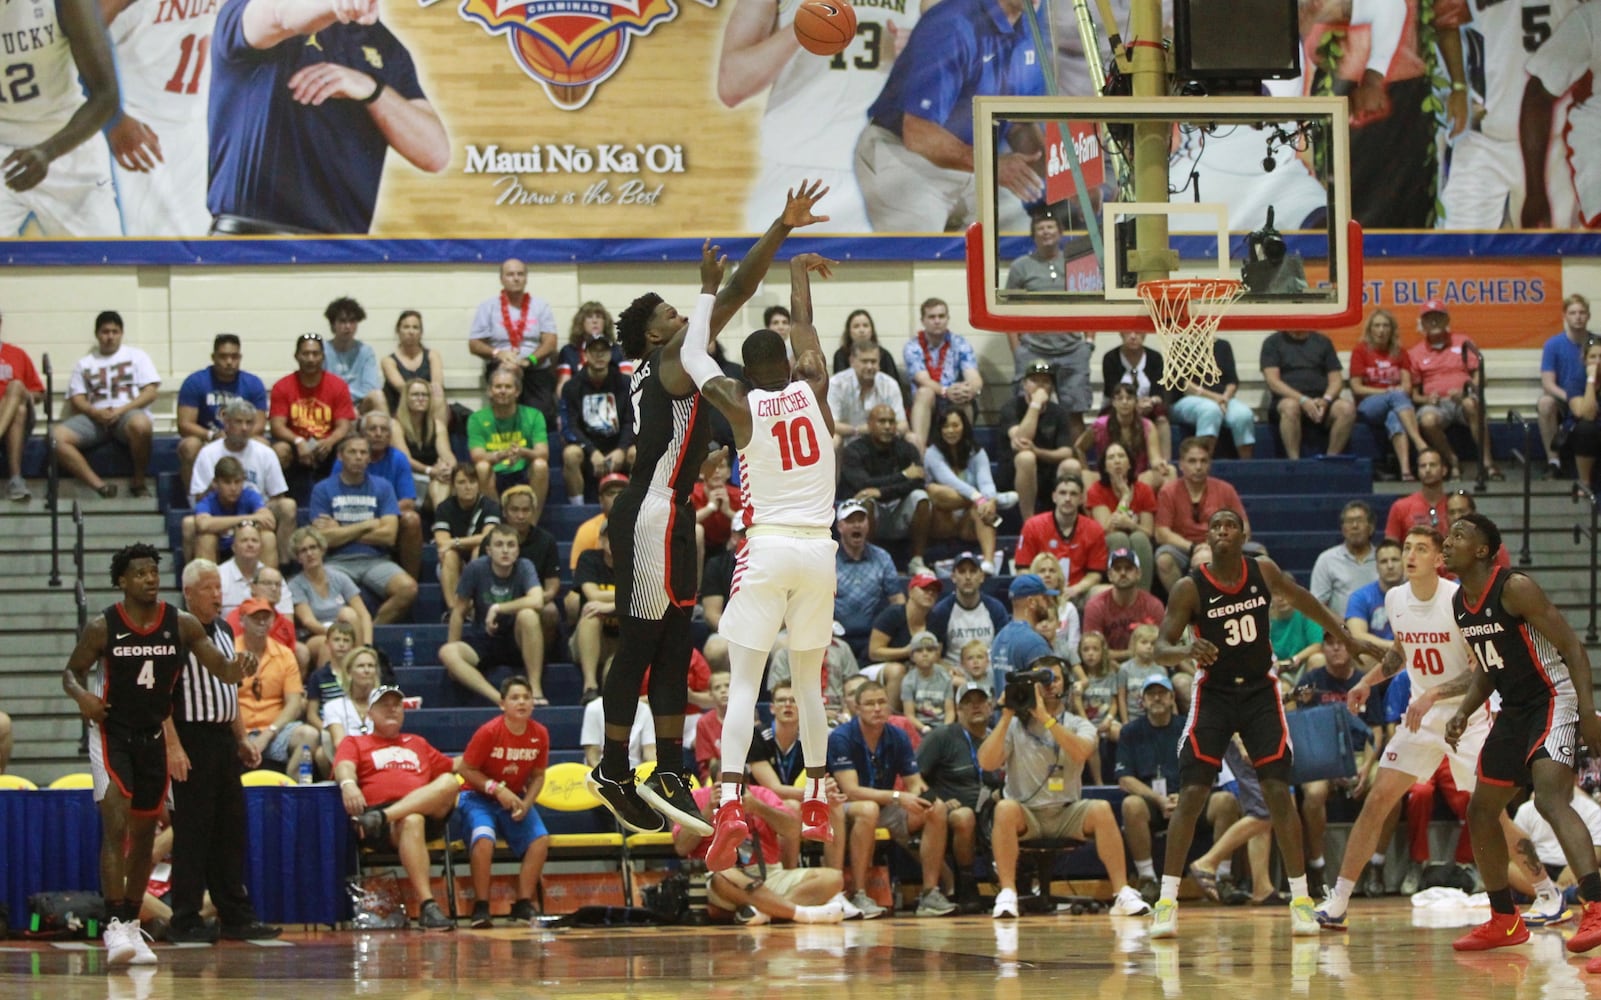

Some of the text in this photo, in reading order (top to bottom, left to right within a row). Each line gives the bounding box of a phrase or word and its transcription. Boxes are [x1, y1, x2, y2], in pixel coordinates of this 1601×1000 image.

[527, 1, 609, 14] CHAMINADE
[1521, 4, 1552, 53] 5
[464, 145, 543, 173] Maui
[546, 145, 593, 173] Nō
[492, 175, 664, 207] Maui is the Best
[1394, 279, 1544, 305] BLEACHERS
[757, 390, 811, 417] CRUTCHER
[771, 415, 820, 471] 10
[1207, 595, 1267, 619] GEORGIA
[1223, 614, 1257, 646] 30
[112, 645, 177, 657] GEORGIA
[1412, 647, 1445, 676] 40
[1473, 639, 1505, 673] 14
[136, 659, 156, 690] 4
